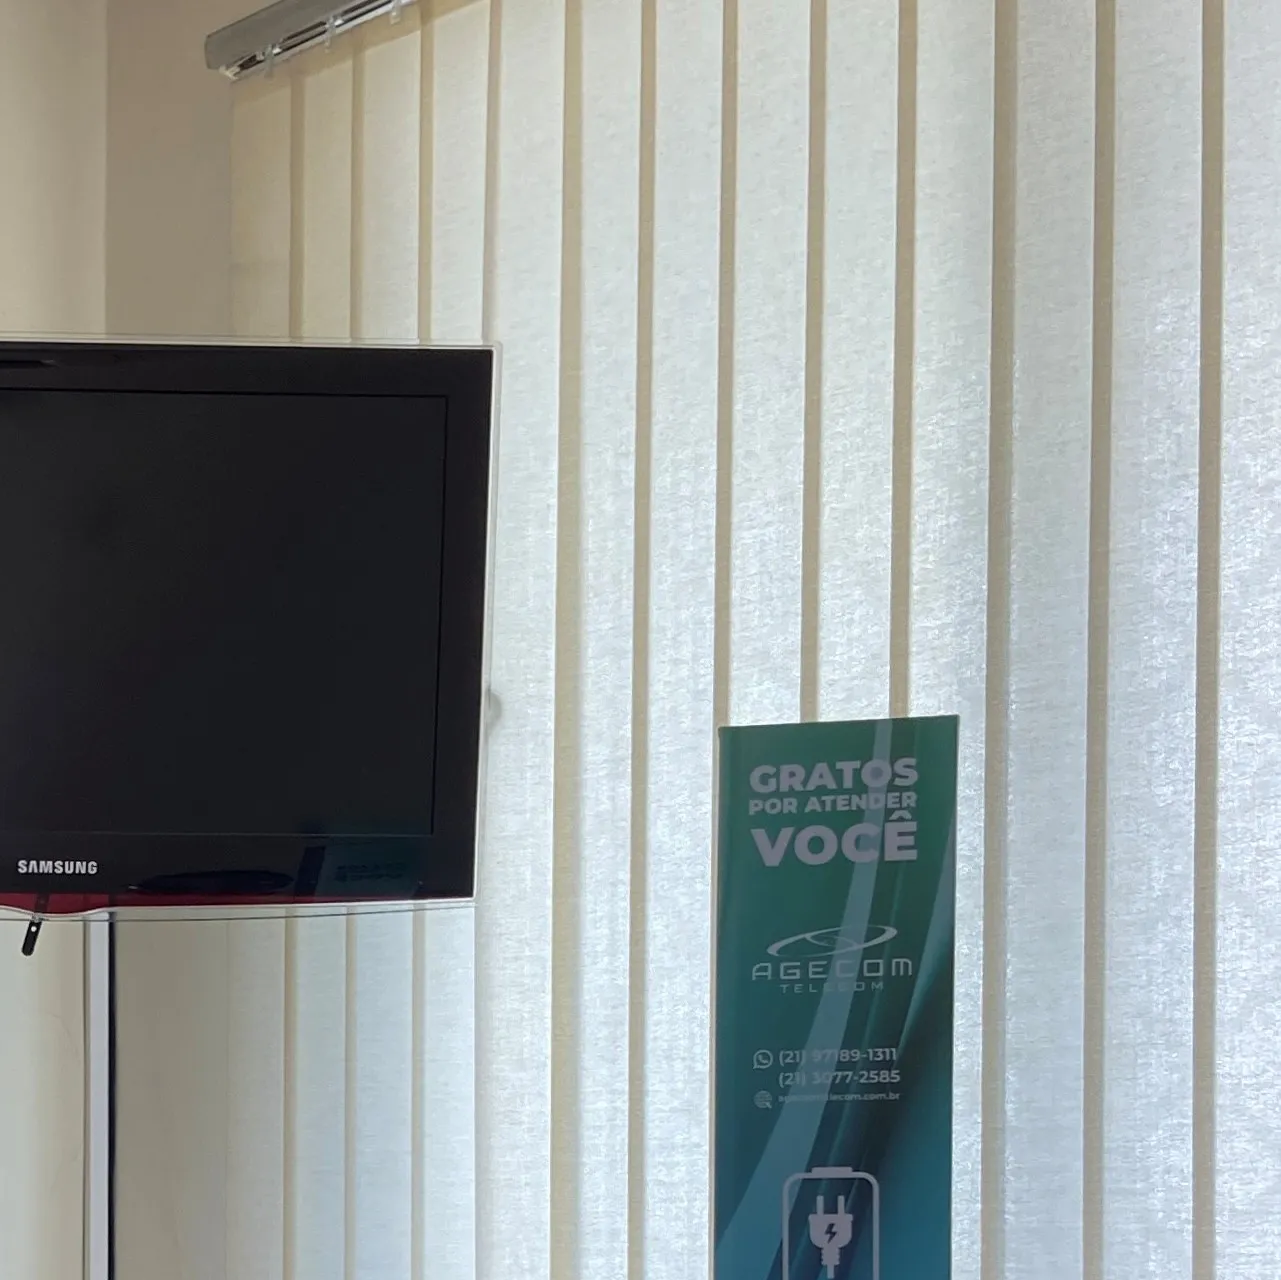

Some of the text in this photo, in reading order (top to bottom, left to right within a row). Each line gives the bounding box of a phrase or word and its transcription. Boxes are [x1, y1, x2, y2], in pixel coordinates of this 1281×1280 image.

[749, 757, 918, 793] GRATOS
[748, 791, 918, 815] POR ATENDER
[750, 809, 918, 867] VOCÊ
[17, 859, 98, 875] SAMSUNG
[752, 957, 913, 980] AGECOM
[779, 1050, 806, 1067] (21)
[778, 1072, 806, 1088] (21)
